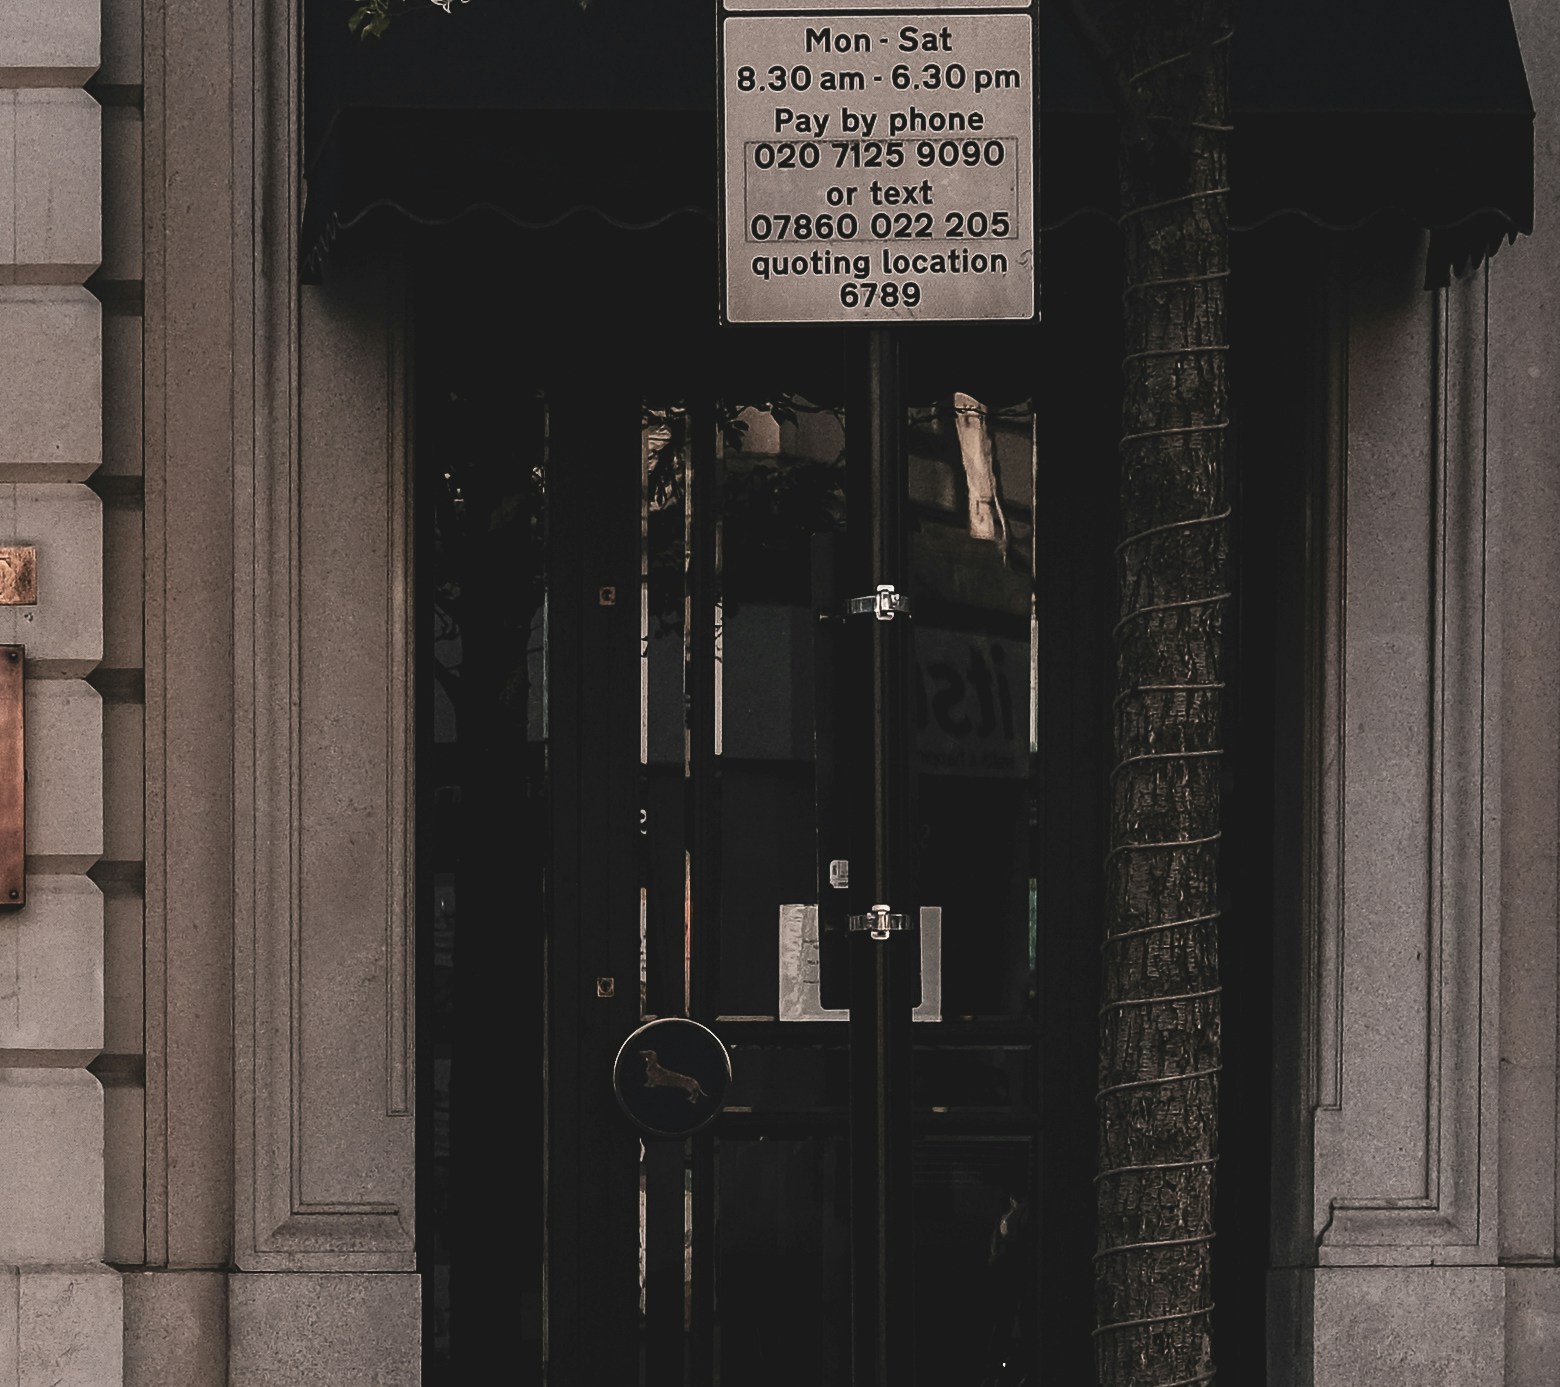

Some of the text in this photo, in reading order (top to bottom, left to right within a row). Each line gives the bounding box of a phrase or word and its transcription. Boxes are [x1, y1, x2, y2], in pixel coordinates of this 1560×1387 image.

[805, 27, 871, 53] Mon
[898, 26, 952, 52] Sat
[737, 66, 812, 91] 8.30
[820, 70, 865, 91] am
[892, 64, 966, 90] 6.30
[974, 69, 1020, 93] pm
[775, 107, 984, 137] Pay by phone
[754, 140, 1005, 169] 020 7125 9090
[826, 180, 933, 206] or text
[751, 212, 1010, 240] 07860 022 205
[752, 249, 1008, 279] quoting location
[840, 282, 921, 308] 6789
